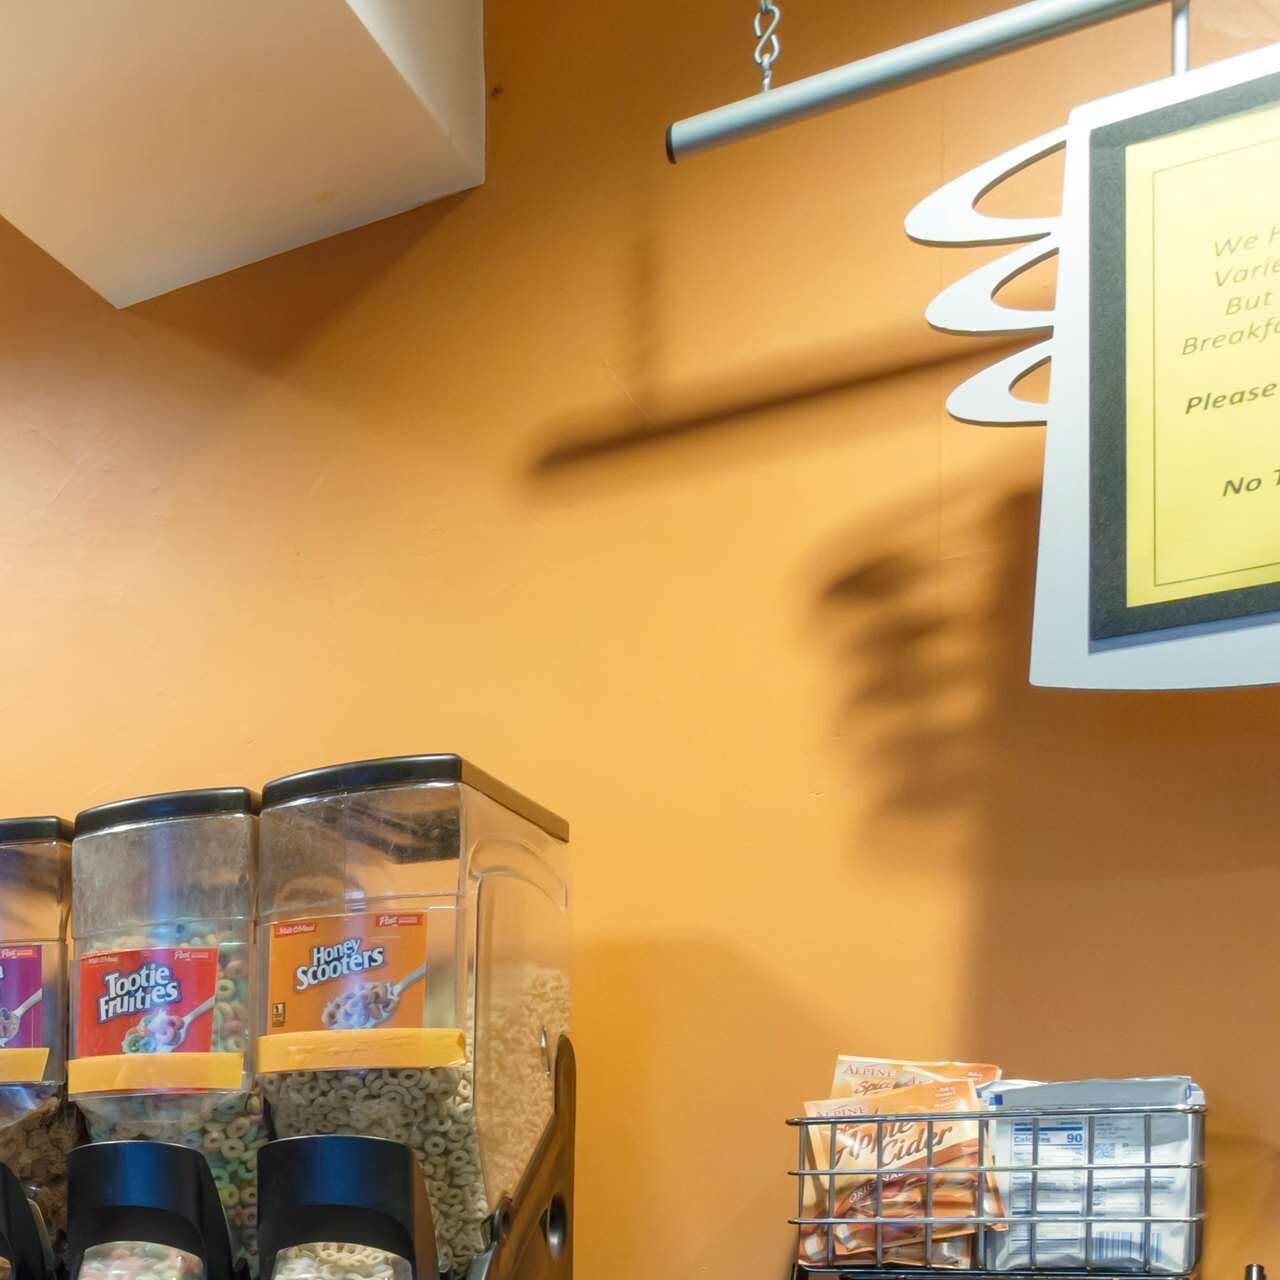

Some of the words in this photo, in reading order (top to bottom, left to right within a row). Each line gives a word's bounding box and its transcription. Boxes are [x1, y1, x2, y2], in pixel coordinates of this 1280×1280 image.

[1214, 233, 1259, 258] We
[1224, 291, 1276, 317] But
[1184, 382, 1278, 415] Please
[1222, 476, 1263, 497] No
[311, 937, 361, 967] Honey
[104, 962, 170, 1000] Tootie
[295, 946, 385, 991] Scooters
[98, 981, 178, 1022] Fruities
[1066, 1133, 1083, 1144] 90
